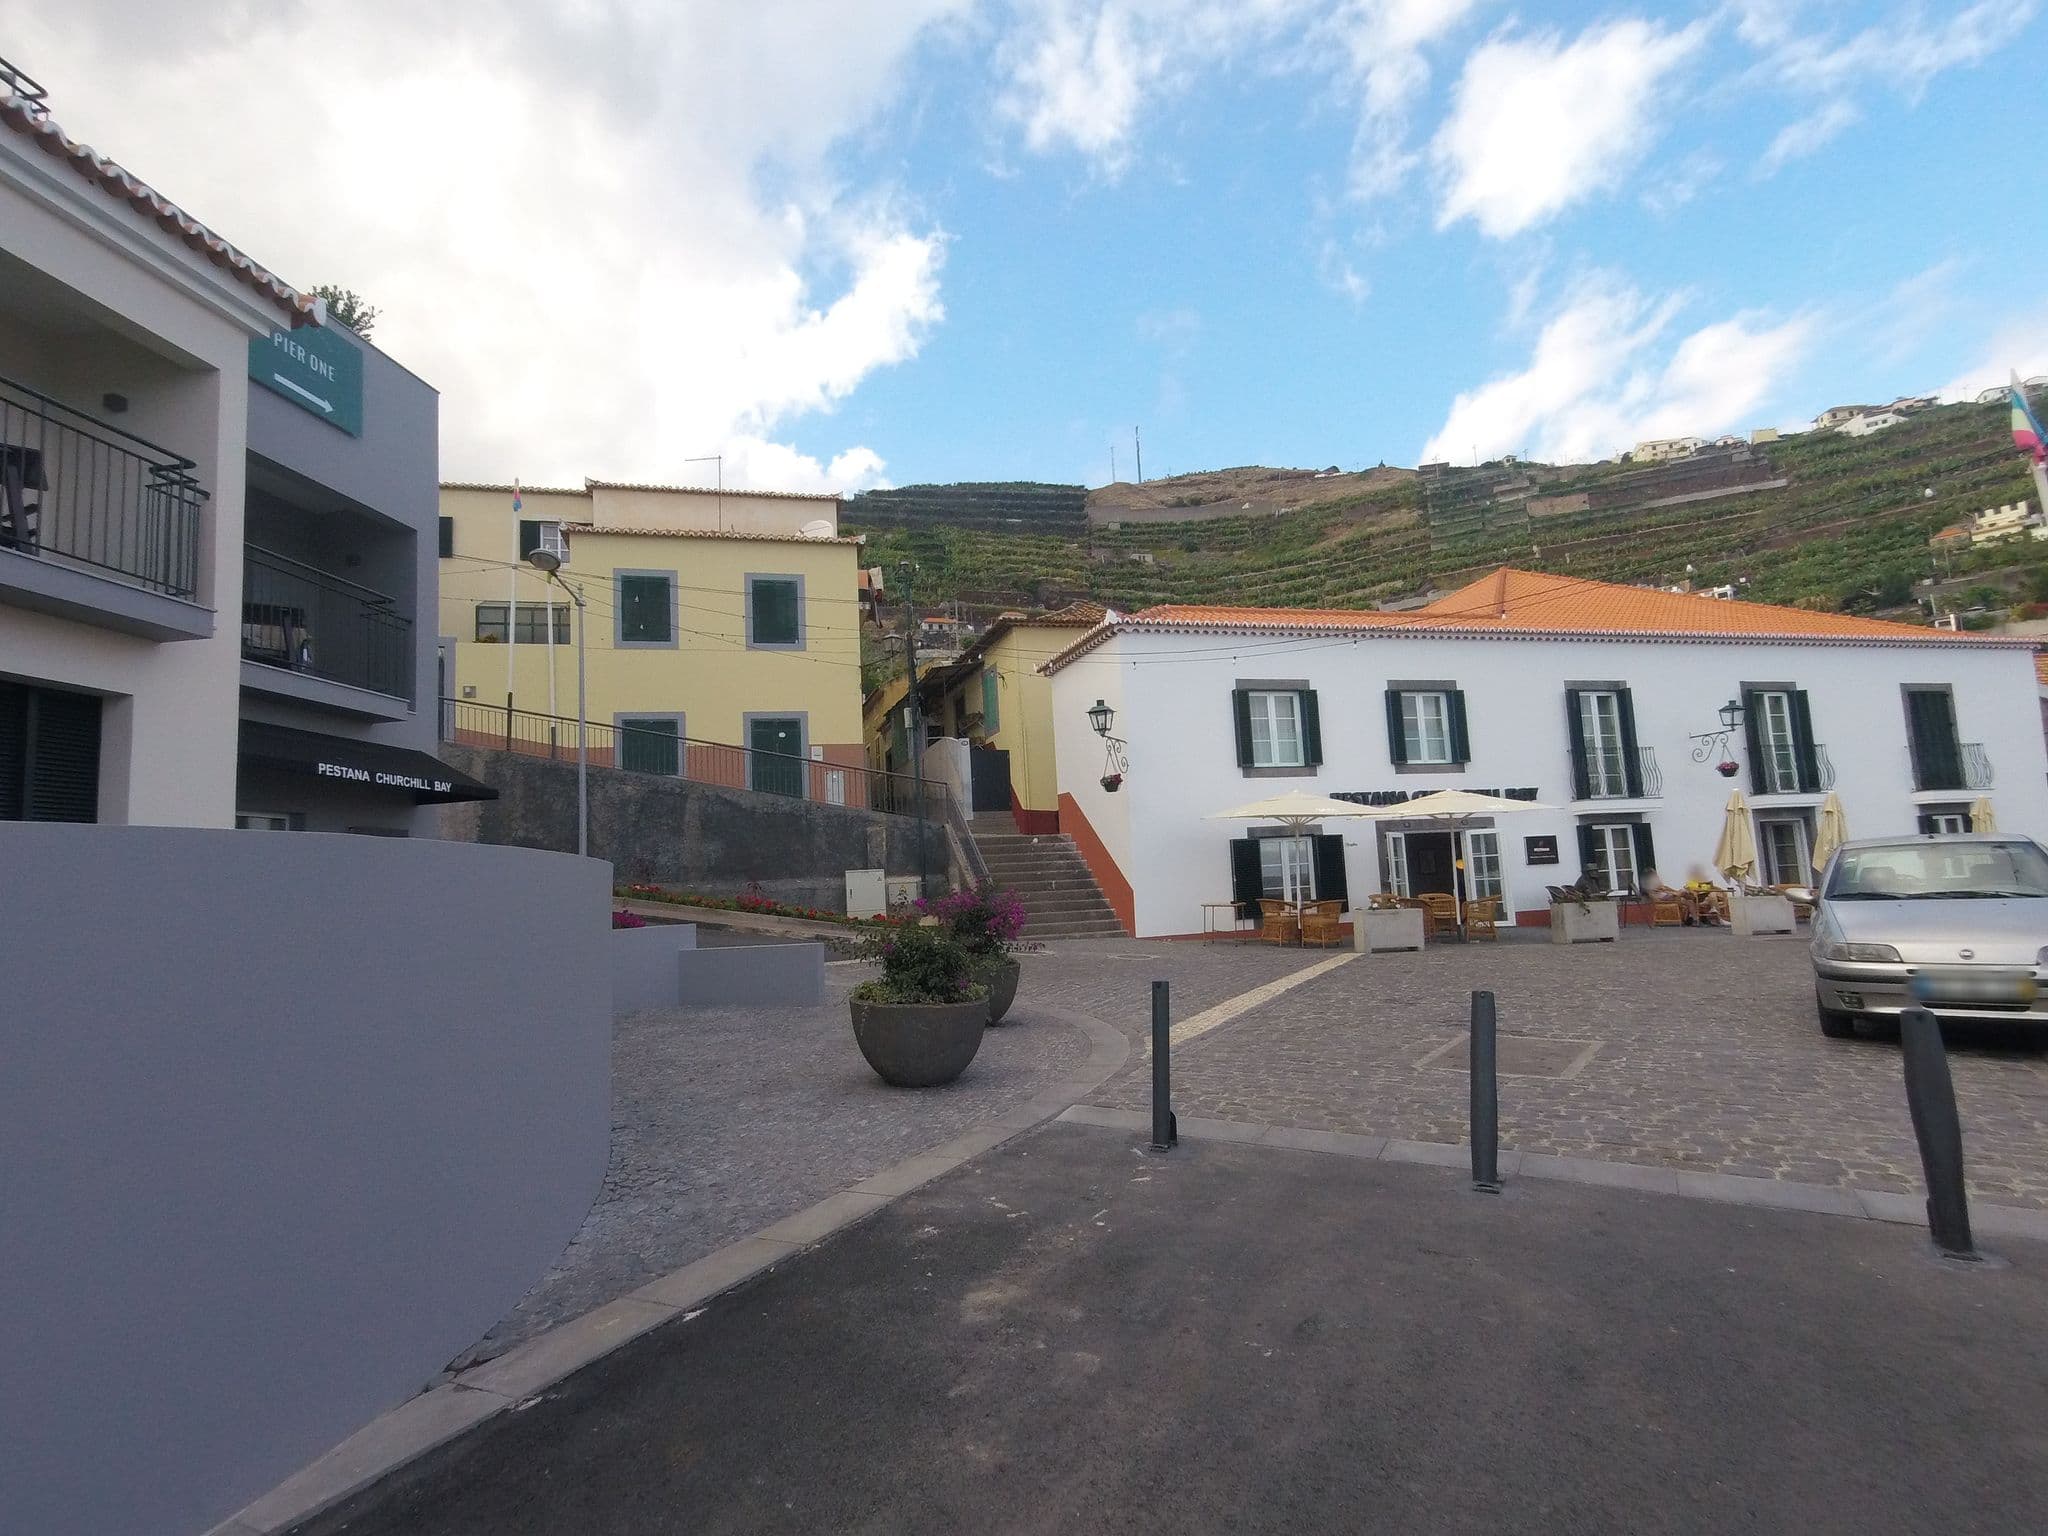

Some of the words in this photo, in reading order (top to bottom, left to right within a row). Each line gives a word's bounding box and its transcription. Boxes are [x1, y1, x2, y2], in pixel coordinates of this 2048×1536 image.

[274, 333, 305, 364] PIER
[310, 354, 335, 382] ONE
[318, 763, 370, 781] PESTANA
[376, 773, 431, 790] CHURCHILL
[434, 781, 452, 792] BAY
